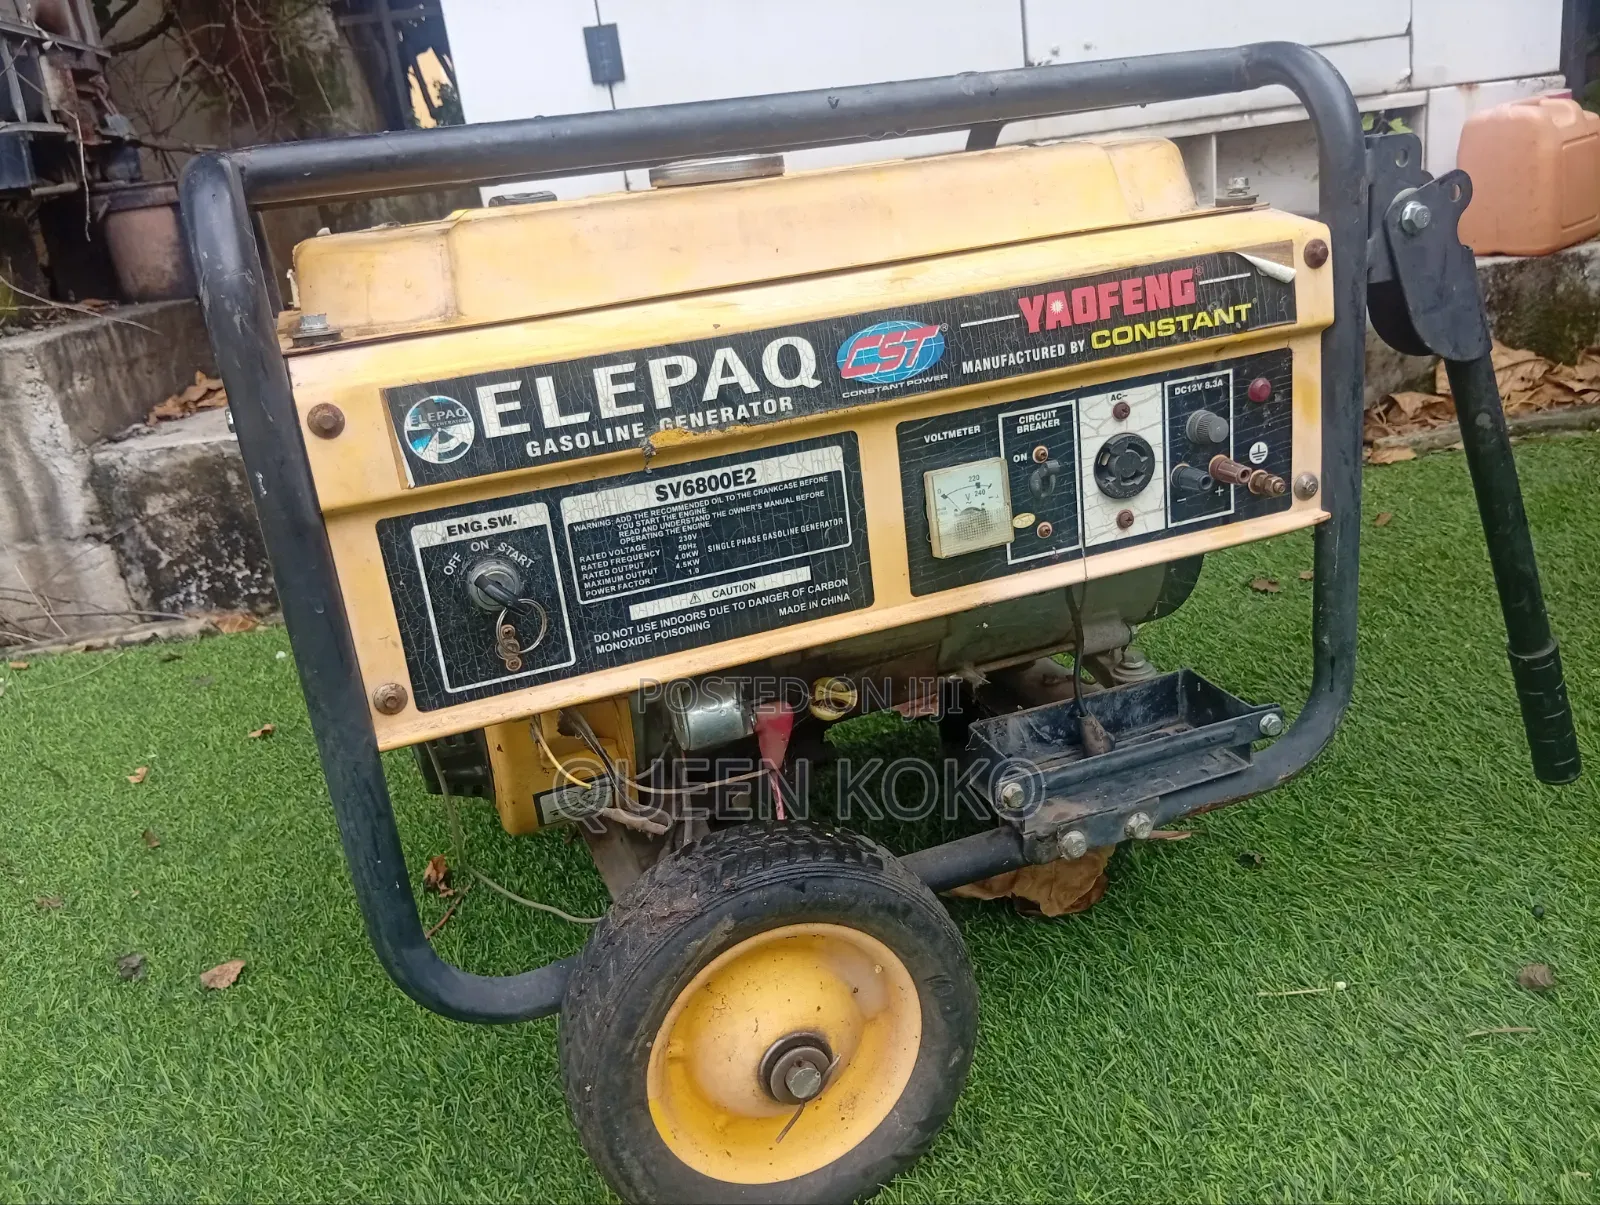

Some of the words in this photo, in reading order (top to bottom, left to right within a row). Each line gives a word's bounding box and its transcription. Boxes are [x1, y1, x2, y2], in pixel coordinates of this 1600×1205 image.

[1018, 268, 1196, 334] YAOFENG
[1091, 302, 1252, 350] CONSTANT
[841, 324, 940, 379] CST
[962, 343, 1065, 374] MANUFACTURED
[1070, 339, 1085, 353] BY
[476, 336, 822, 439] ELEPAQ
[842, 381, 905, 398] CONSTANT
[907, 373, 948, 387] POWER
[1174, 384, 1203, 396] DC12V
[1204, 379, 1224, 390] 8.3A
[410, 407, 467, 425] ELEPAQ
[526, 422, 646, 458] GASOLINE
[659, 396, 793, 431] GENERATOR
[1016, 418, 1060, 434] BREAKER
[1018, 410, 1058, 424] CIRCUIT
[923, 425, 981, 444] VOLTMETER
[1012, 453, 1028, 463] ON
[655, 467, 757, 502] SV6800E2
[968, 474, 980, 482] 220
[615, 514, 632, 524] ADD
[634, 511, 649, 520] THE
[651, 500, 710, 517] RECOMMENDED
[711, 494, 723, 504] OIL
[725, 494, 736, 502] TO
[738, 491, 752, 500] THE
[753, 481, 799, 497] CRANKCASE
[800, 475, 827, 487] BEFORE
[974, 489, 986, 497] 240
[446, 514, 517, 537] ENG.SW.
[617, 522, 634, 531] YOU
[636, 517, 660, 527] START
[662, 514, 677, 522] THE
[619, 528, 640, 538] READ
[642, 524, 658, 533] AND
[659, 513, 710, 530] UNDERSTAND
[712, 510, 727, 519] THE
[728, 503, 763, 516] OWNER'S
[764, 494, 794, 508] MANUAL
[796, 490, 825, 502] BEFORE
[470, 540, 490, 552] ON
[620, 530, 664, 545] OPERATING
[665, 527, 680, 536] THE
[682, 521, 712, 533] ENGINE.
[707, 539, 736, 553] SINGLE
[737, 534, 761, 547] PHASE
[763, 526, 799, 541] GASOLINE
[801, 517, 843, 533] GENERATOR
[498, 542, 535, 569] START
[579, 551, 607, 564] RATED
[609, 544, 647, 557] VOLTAGE
[678, 533, 698, 543] 230V
[581, 560, 609, 572] RATED
[610, 550, 661, 565] FREQUENCY
[678, 543, 697, 552] 50Hz
[443, 552, 464, 576] OFF
[582, 569, 610, 580] RATED
[612, 562, 645, 574] OUTPUT
[674, 550, 699, 560] 4.0KW
[584, 575, 624, 588] MAXIMUM
[623, 567, 658, 581] OUTPUT
[676, 558, 700, 569] 4.5KW
[585, 585, 616, 597] POWER
[618, 578, 651, 590] FACTOR
[688, 567, 700, 576] 1.0
[712, 581, 756, 598] CAUTION
[594, 633, 610, 643] DO
[612, 626, 634, 638] NOT
[637, 621, 658, 633] USE
[660, 610, 707, 627] INDOORS
[709, 605, 730, 617] DUE
[732, 599, 746, 611] TO
[749, 591, 790, 608] DANGER
[792, 587, 805, 598] OF
[807, 577, 849, 594] CARBON
[779, 602, 807, 616] MADE
[809, 599, 819, 610] IN
[820, 593, 850, 607] CHINA
[596, 634, 652, 654] MONOXIDE
[654, 621, 711, 641] POISONING
